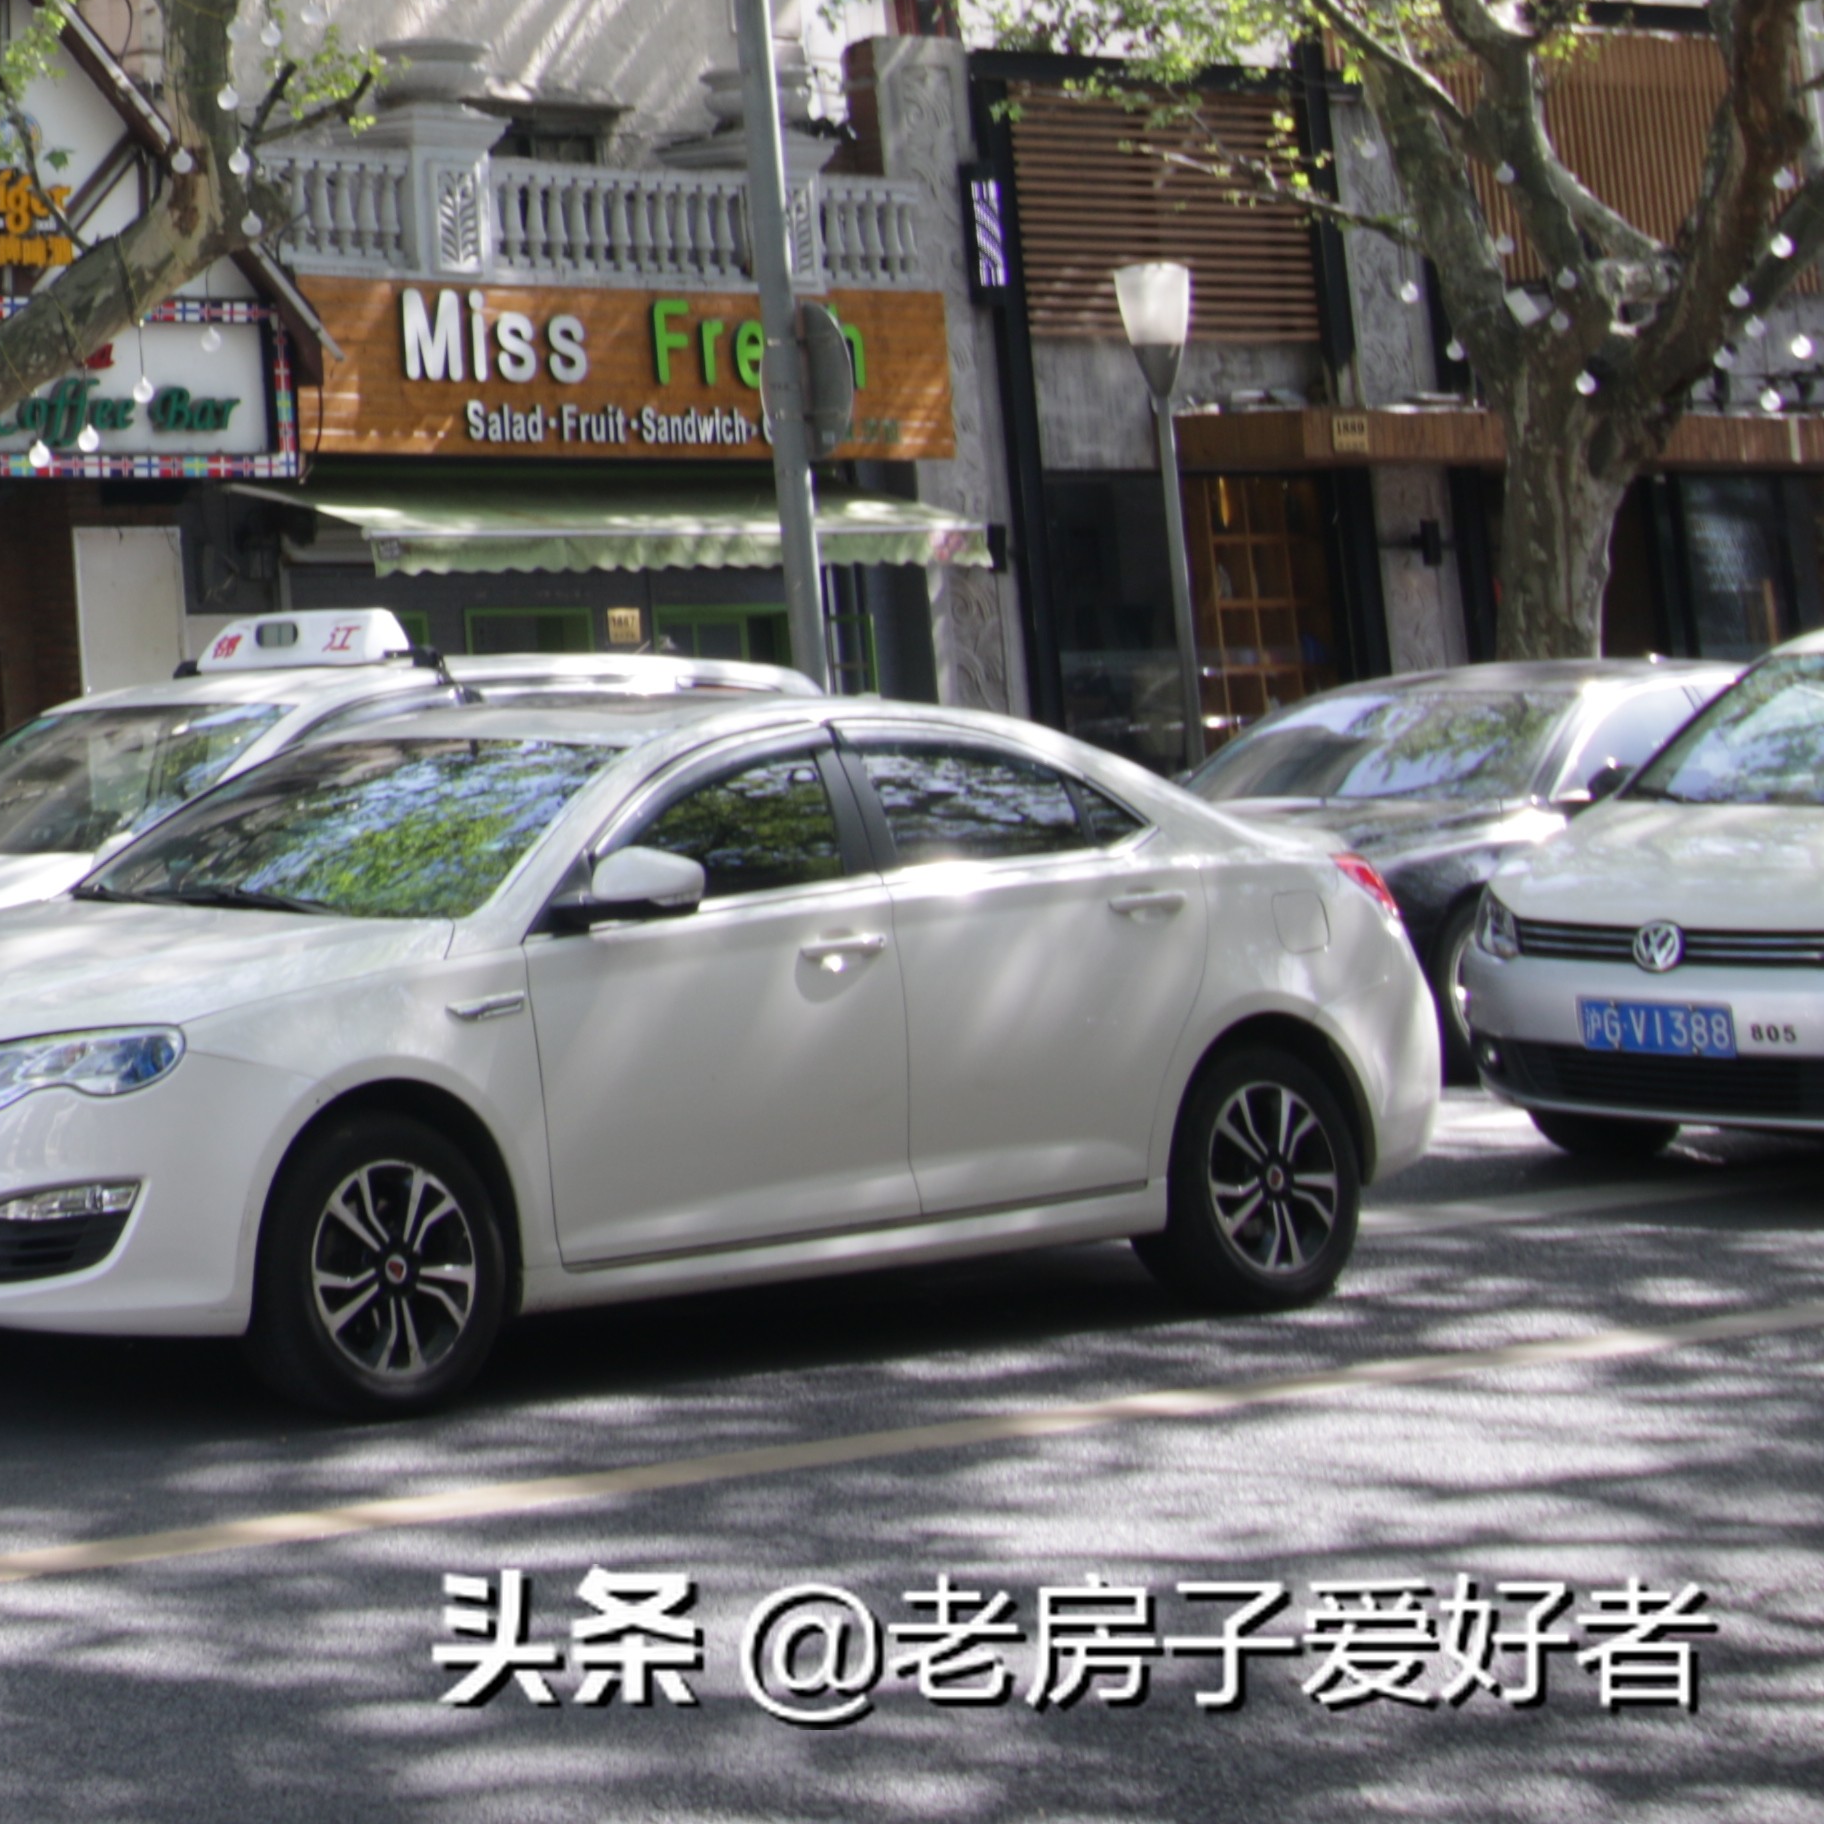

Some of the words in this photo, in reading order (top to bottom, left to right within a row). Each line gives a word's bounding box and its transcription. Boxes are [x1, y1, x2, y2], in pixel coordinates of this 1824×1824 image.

[402, 287, 588, 384] Miss
[653, 299, 866, 389] Freh
[152, 384, 241, 433] Bar
[1750, 1023, 1796, 1043] 805
